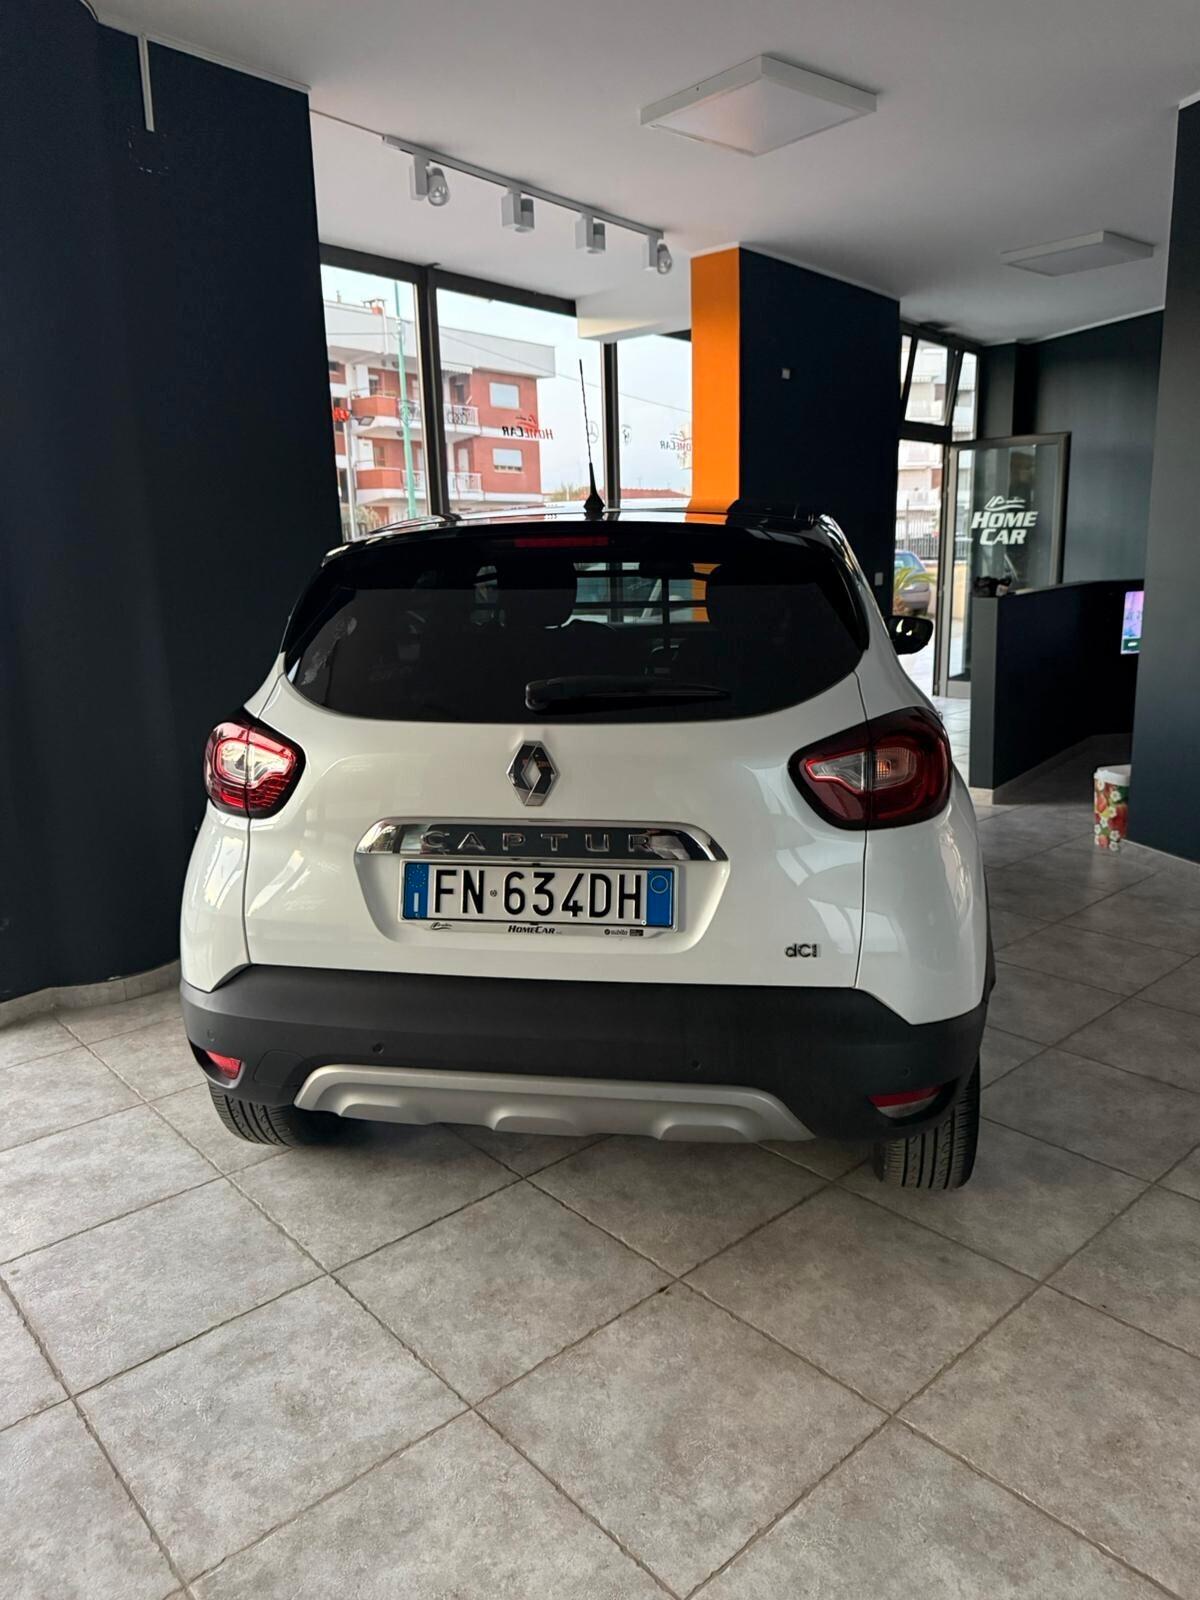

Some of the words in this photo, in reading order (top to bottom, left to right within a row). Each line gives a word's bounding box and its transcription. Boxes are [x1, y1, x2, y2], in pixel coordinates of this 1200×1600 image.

[970, 511, 1038, 529] HOME
[979, 528, 1027, 545] CAR
[421, 830, 650, 853] CAPTUR
[434, 869, 485, 914] FN
[503, 871, 642, 920] 634DH
